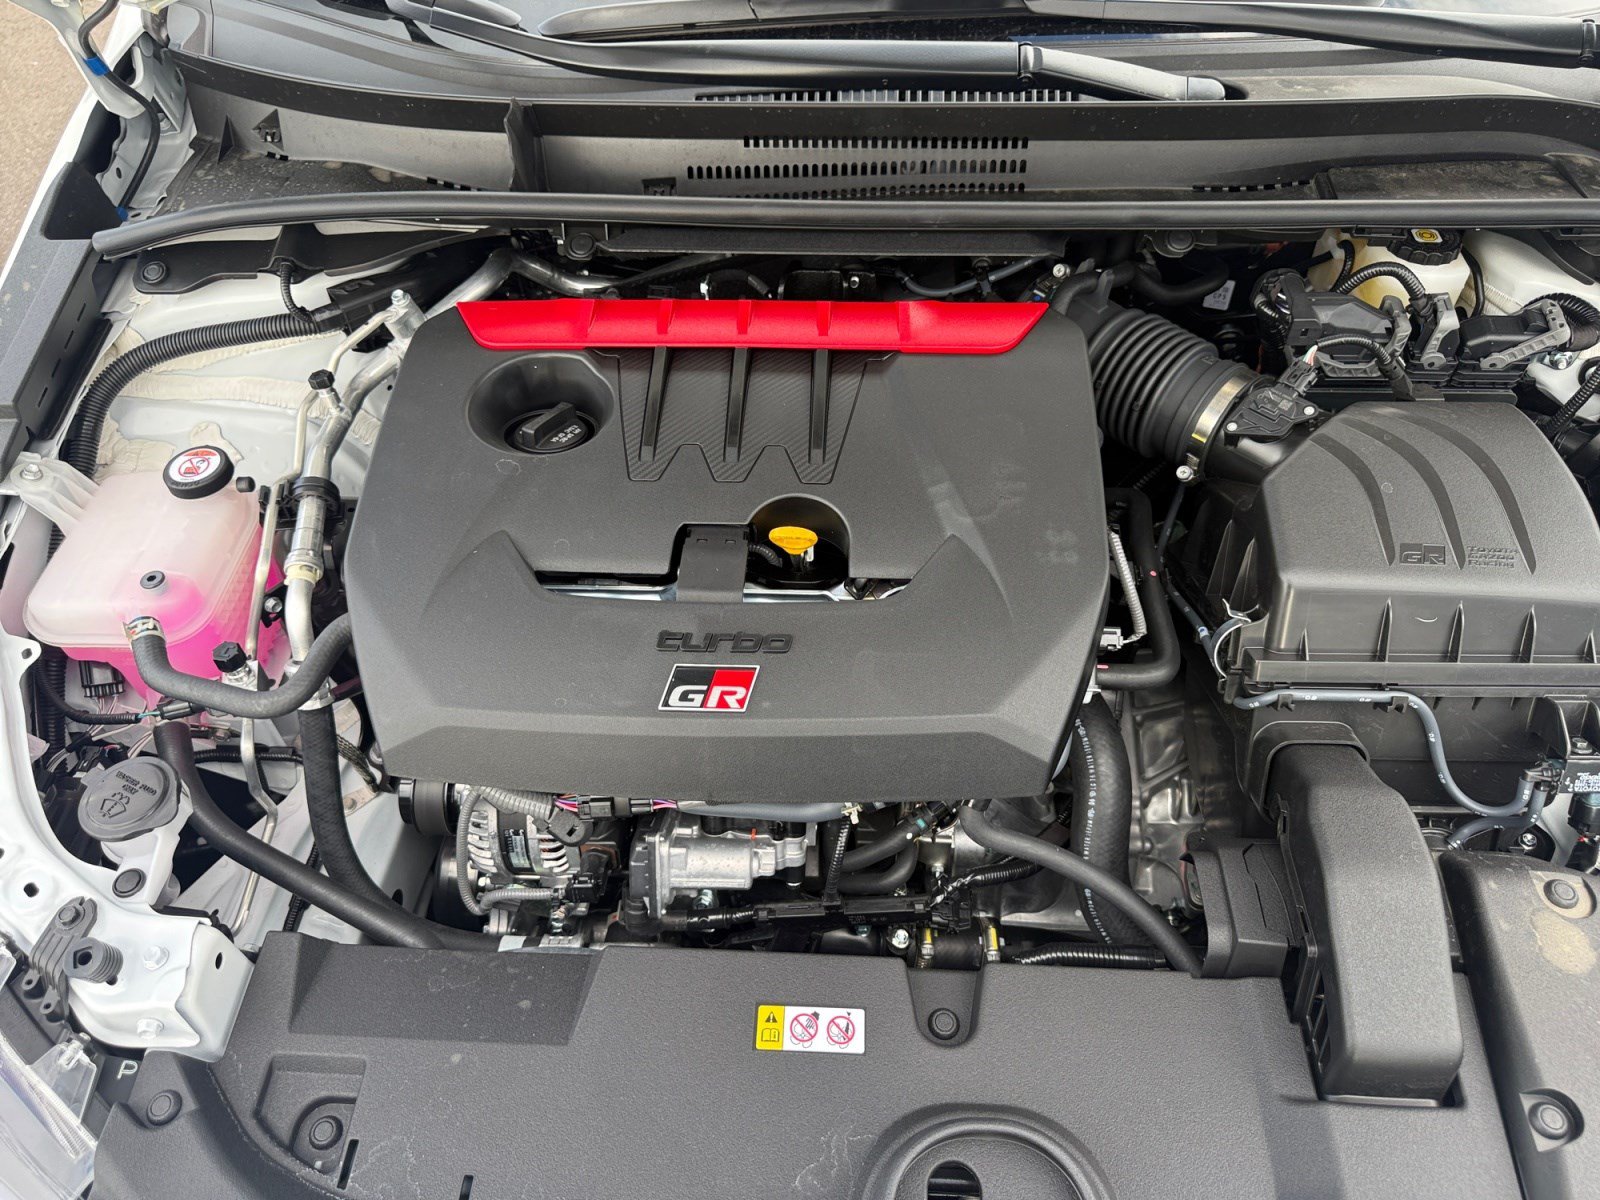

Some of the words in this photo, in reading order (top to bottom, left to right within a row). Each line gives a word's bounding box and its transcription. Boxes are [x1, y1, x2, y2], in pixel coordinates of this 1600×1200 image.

[1401, 549, 1445, 565] GR
[655, 630, 794, 655] turbo
[667, 684, 747, 709] GR
[117, 1060, 138, 1079] P
